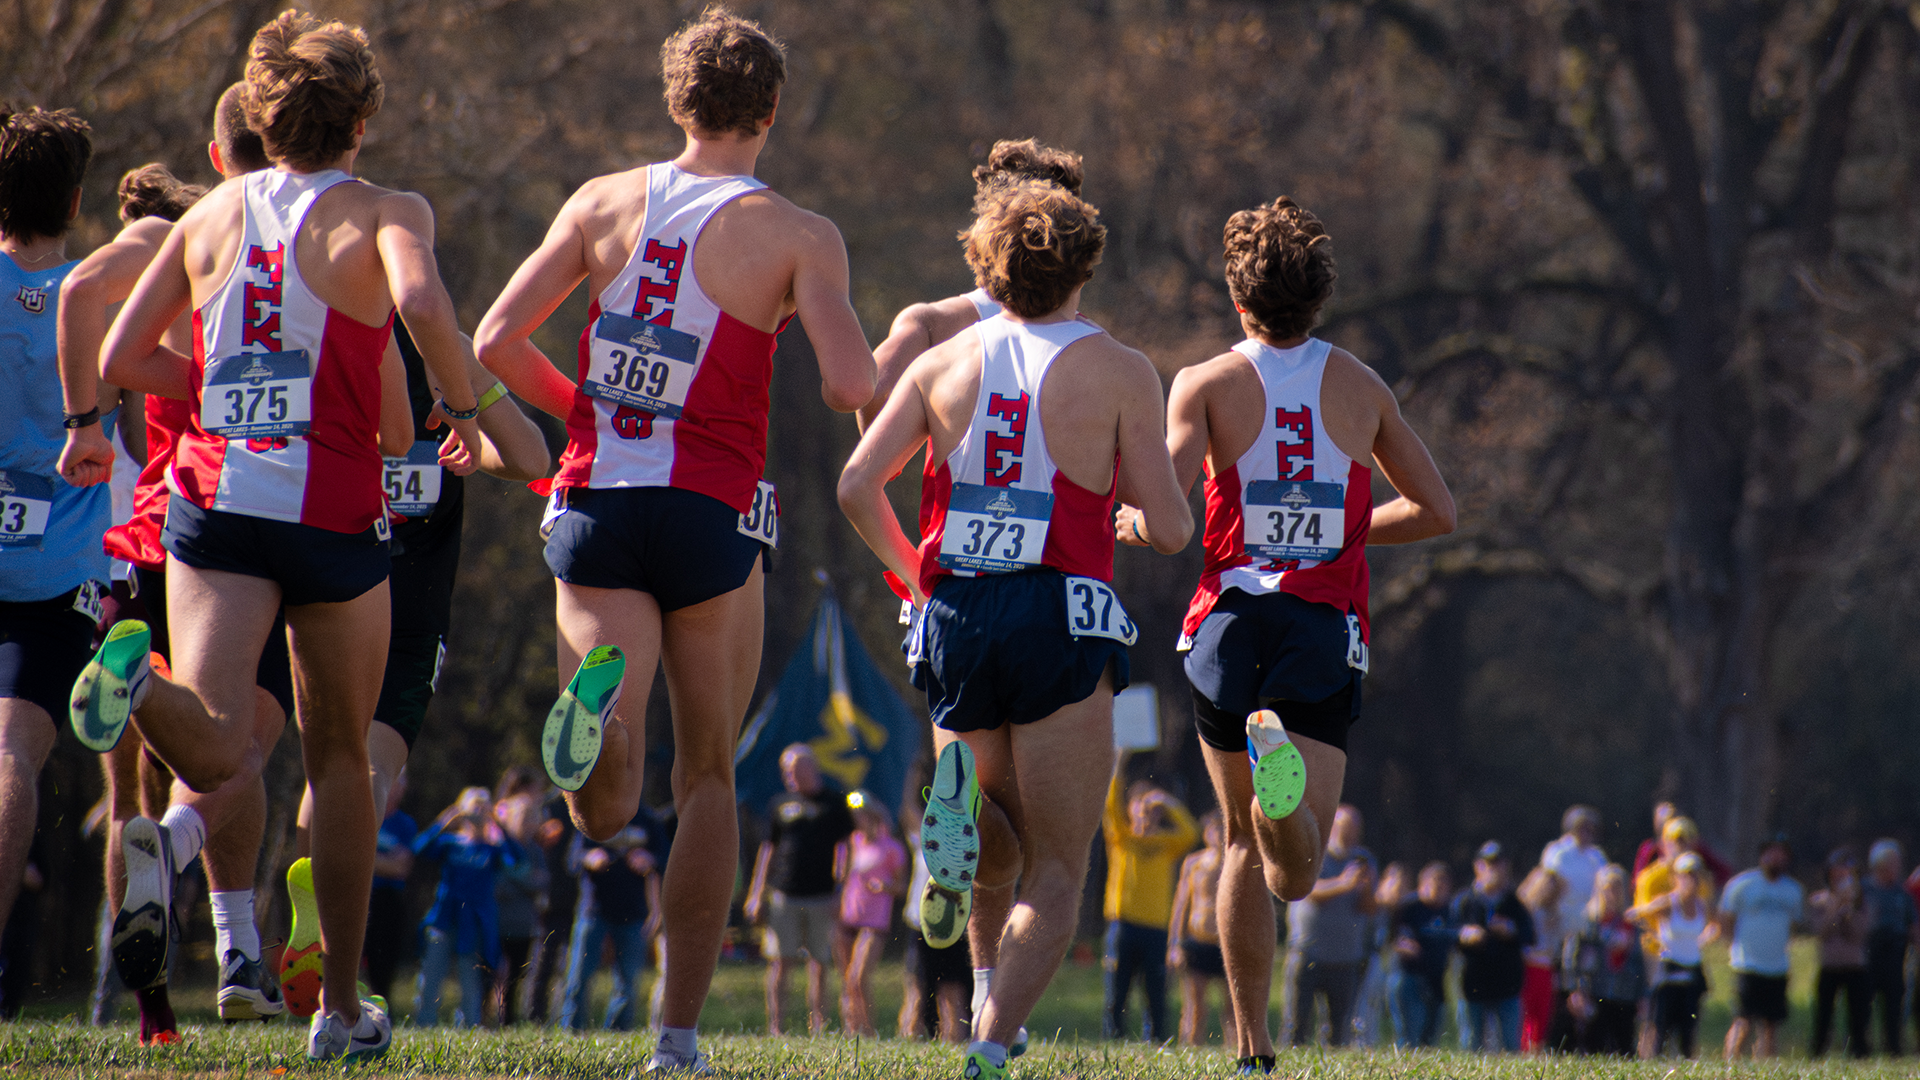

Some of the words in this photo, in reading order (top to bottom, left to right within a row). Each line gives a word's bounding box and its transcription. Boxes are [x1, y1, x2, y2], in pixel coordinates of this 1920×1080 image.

[14, 283, 48, 314] MU
[604, 349, 669, 398] 369
[225, 386, 288, 425] 375
[963, 519, 1025, 560] 373
[1266, 511, 1323, 545] 374
